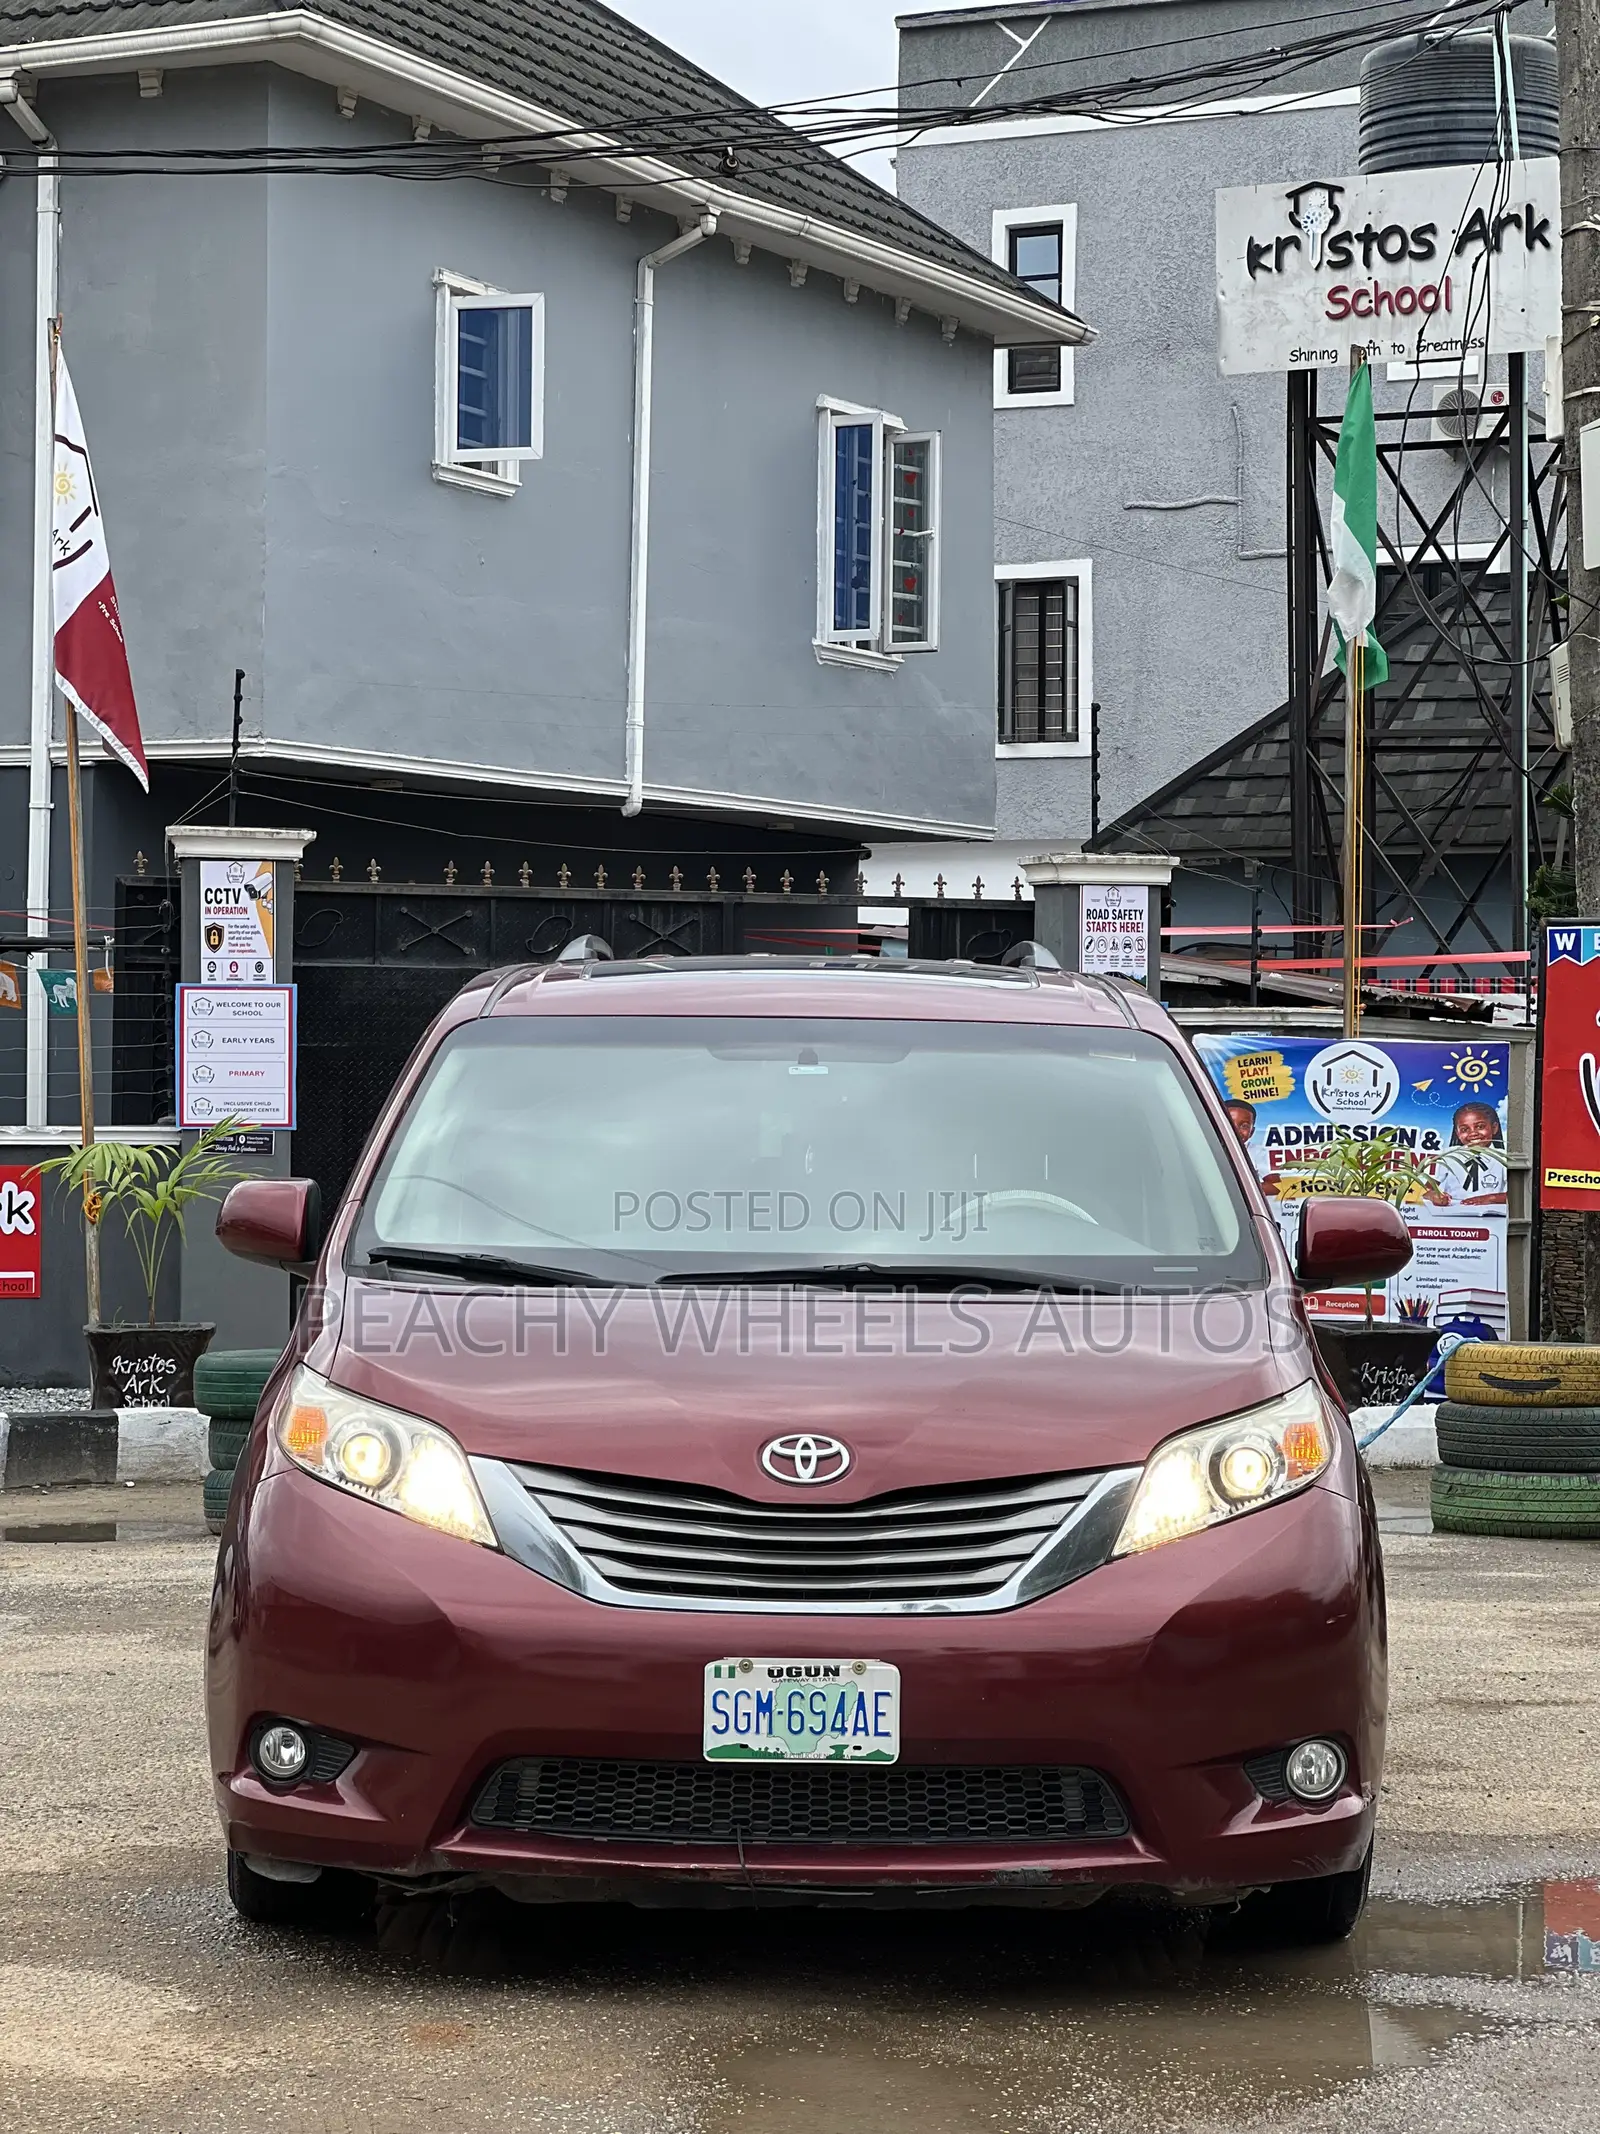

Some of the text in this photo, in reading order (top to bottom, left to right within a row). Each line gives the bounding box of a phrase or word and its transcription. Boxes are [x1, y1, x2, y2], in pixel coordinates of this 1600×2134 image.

[1455, 203, 1552, 256] Ark
[1325, 275, 1453, 320] School
[1289, 347, 1338, 364] Shining
[1391, 342, 1405, 354] to
[204, 887, 242, 905] CCTV
[204, 906, 248, 915] IN OPERATION
[1086, 908, 1144, 920] ROAD SAFETY
[1086, 921, 1144, 933] STARTS HERE!
[1237, 1056, 1273, 1068] LEARN!
[1240, 1066, 1269, 1078] PLAY!
[1241, 1076, 1275, 1089] GROW!
[1243, 1087, 1279, 1100] SHINE!
[1363, 1088, 1382, 1098] Ark
[1336, 1098, 1367, 1106] School
[1265, 1124, 1441, 1151] ADMISSION &
[1417, 1229, 1479, 1238] ENROLL TODAY!
[1325, 1300, 1360, 1309] Reception
[112, 1352, 177, 1375] Kristos
